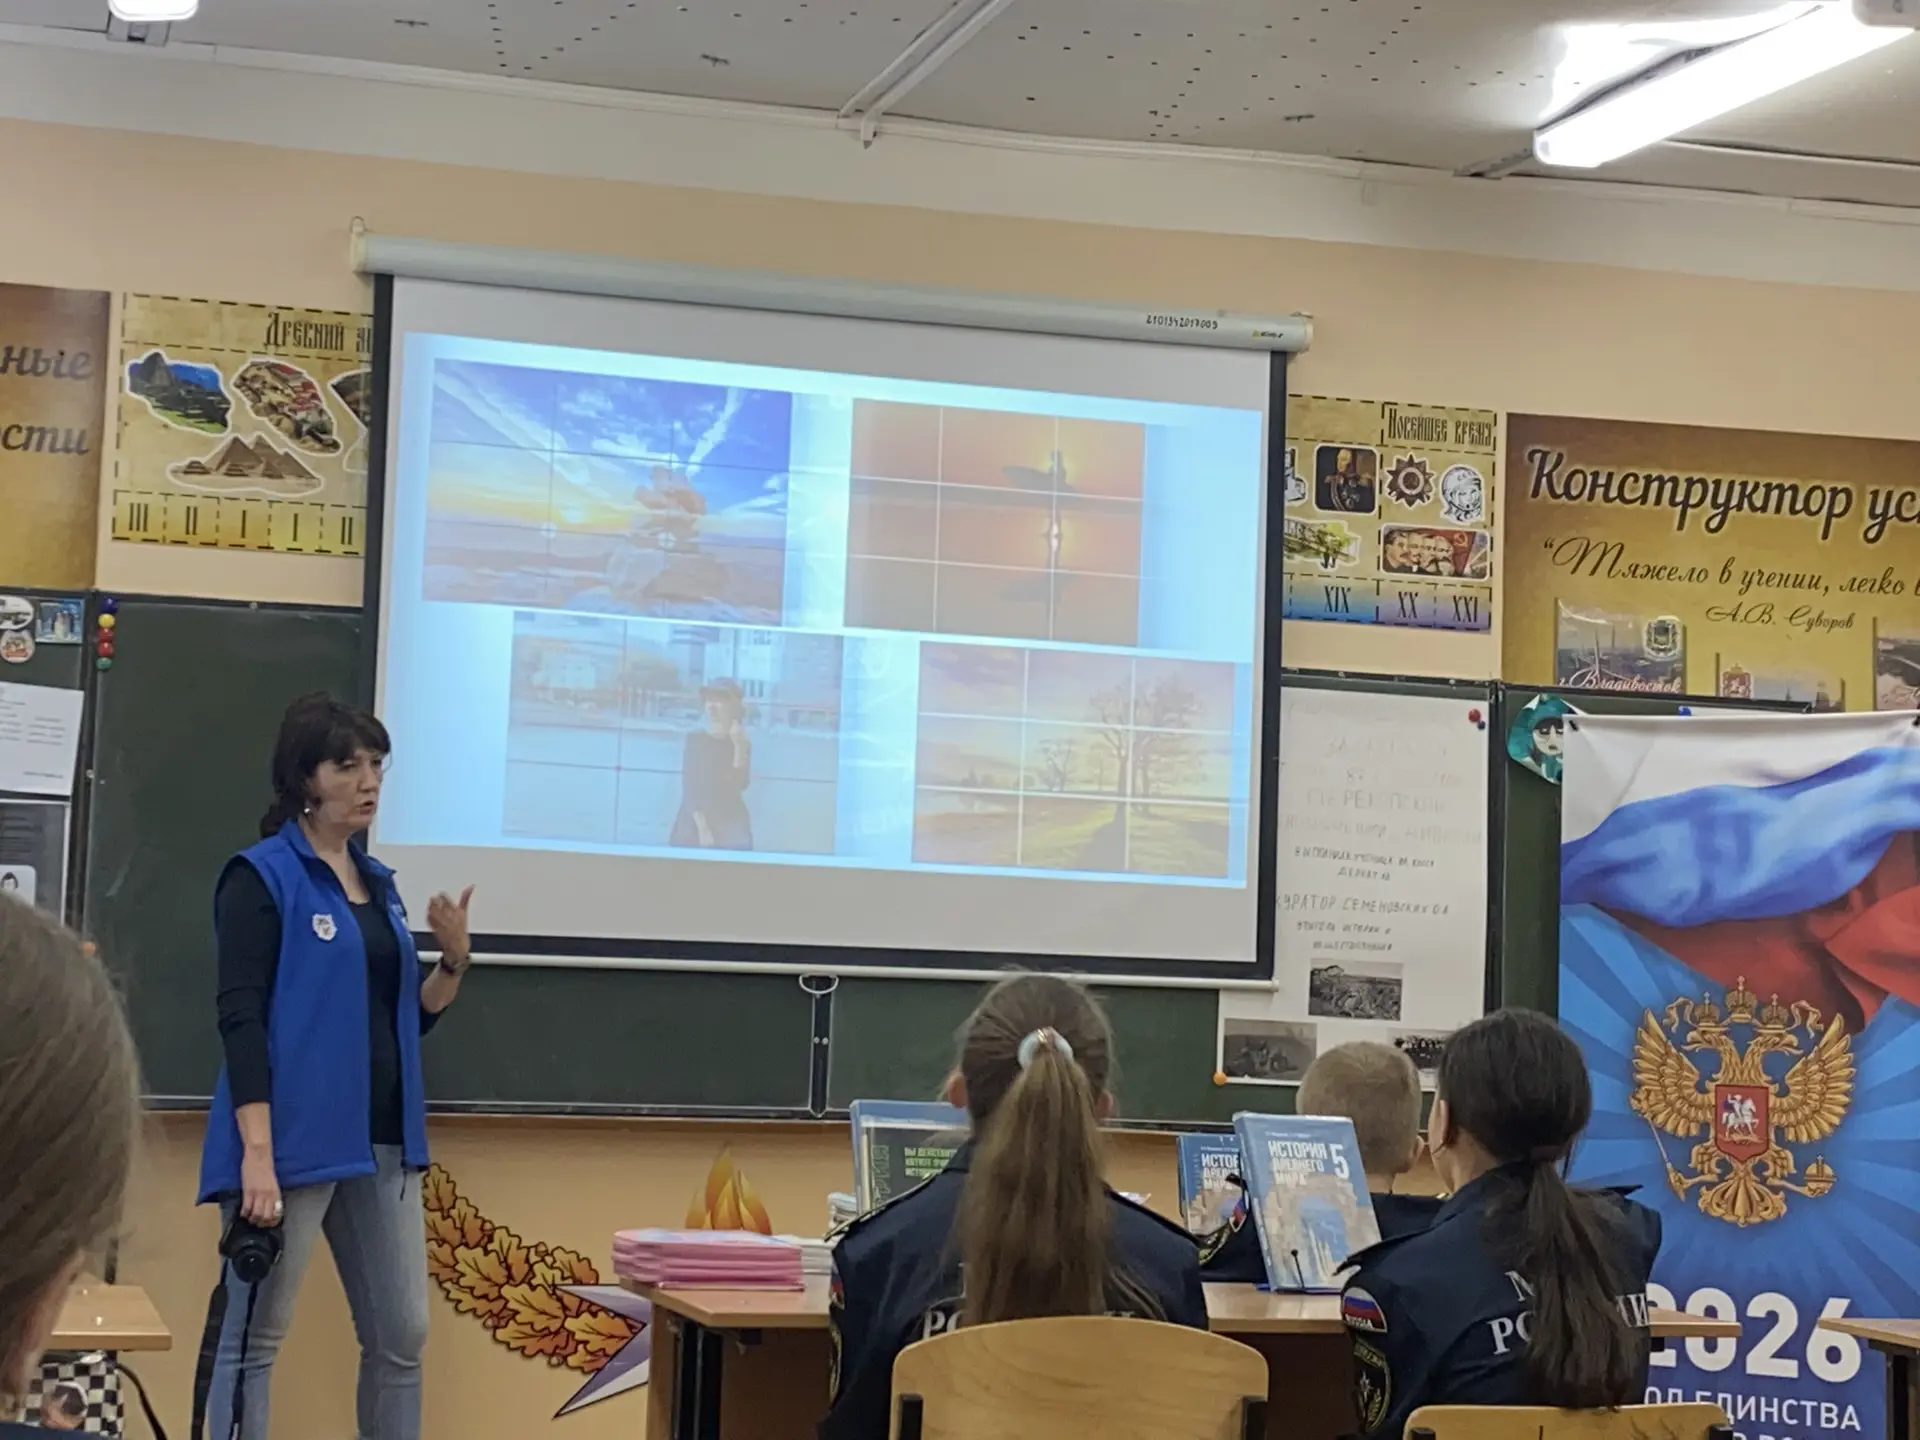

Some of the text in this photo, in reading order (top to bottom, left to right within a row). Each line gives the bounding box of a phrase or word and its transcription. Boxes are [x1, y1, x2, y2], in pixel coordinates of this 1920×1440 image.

[0, 345, 93, 380] ные
[1, 423, 90, 456] сти
[1527, 448, 1920, 544] Конструктор ус
[129, 502, 148, 533] III
[186, 505, 198, 536] II
[1718, 556, 1736, 585] в
[1738, 568, 1829, 597] учении,
[1839, 566, 1905, 596] легко
[1323, 585, 1479, 624] XIX XX XXI
[1705, 601, 1856, 634] А.В. Суворов
[1201, 1152, 1239, 1169] ИСТОР
[1267, 1140, 1328, 1160] ИСТОРИЯ
[1329, 1143, 1350, 1181] 5
[1645, 1283, 1862, 1383] 2026
[1644, 1386, 1683, 1405] ОД
